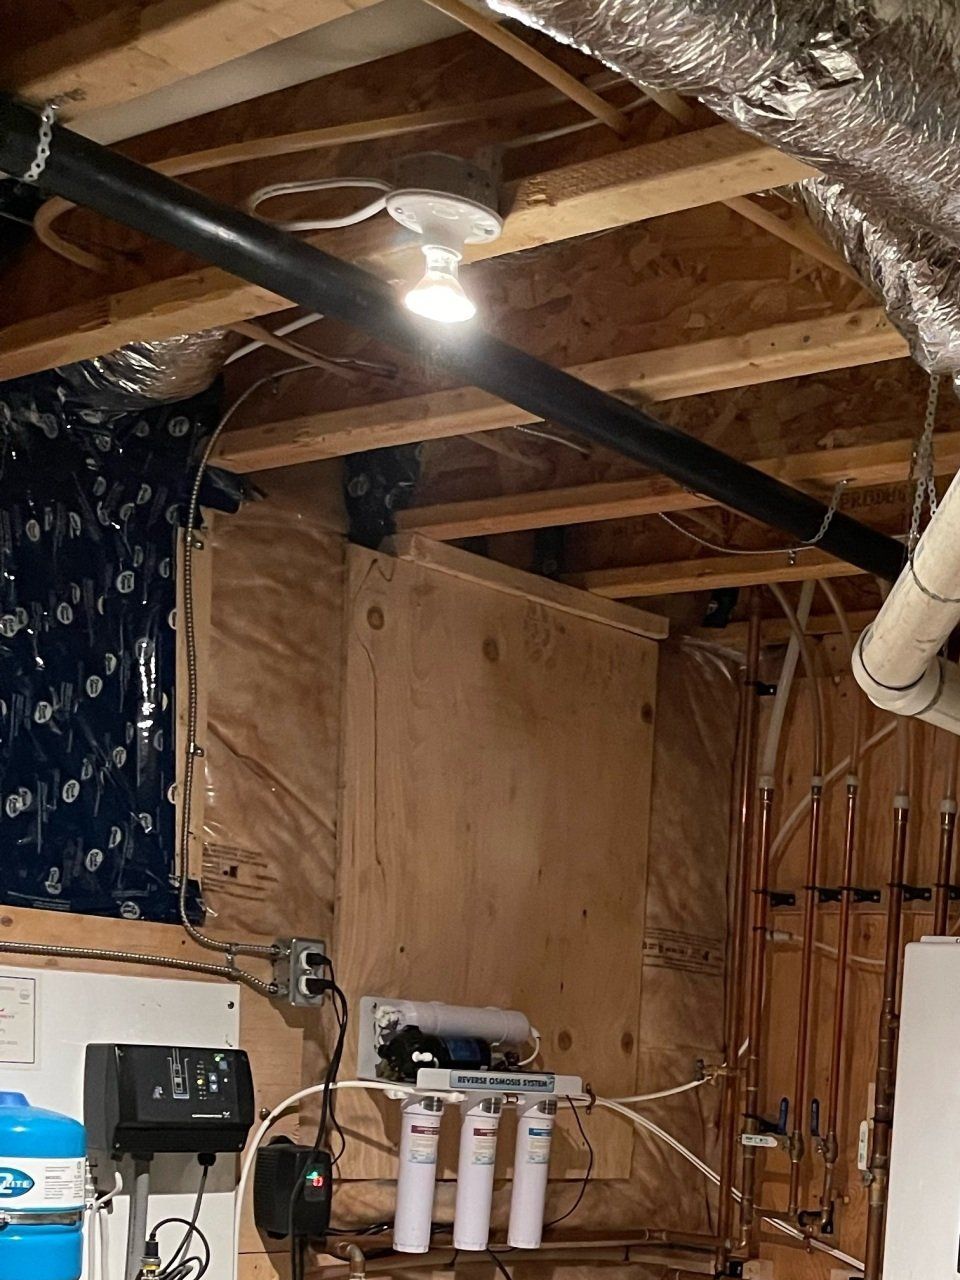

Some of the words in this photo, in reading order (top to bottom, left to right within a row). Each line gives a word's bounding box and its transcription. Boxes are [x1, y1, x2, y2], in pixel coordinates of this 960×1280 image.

[457, 1075, 487, 1085] REVERSE
[489, 1076, 521, 1087] OSMOSIS
[522, 1078, 548, 1088] SYSTEM
